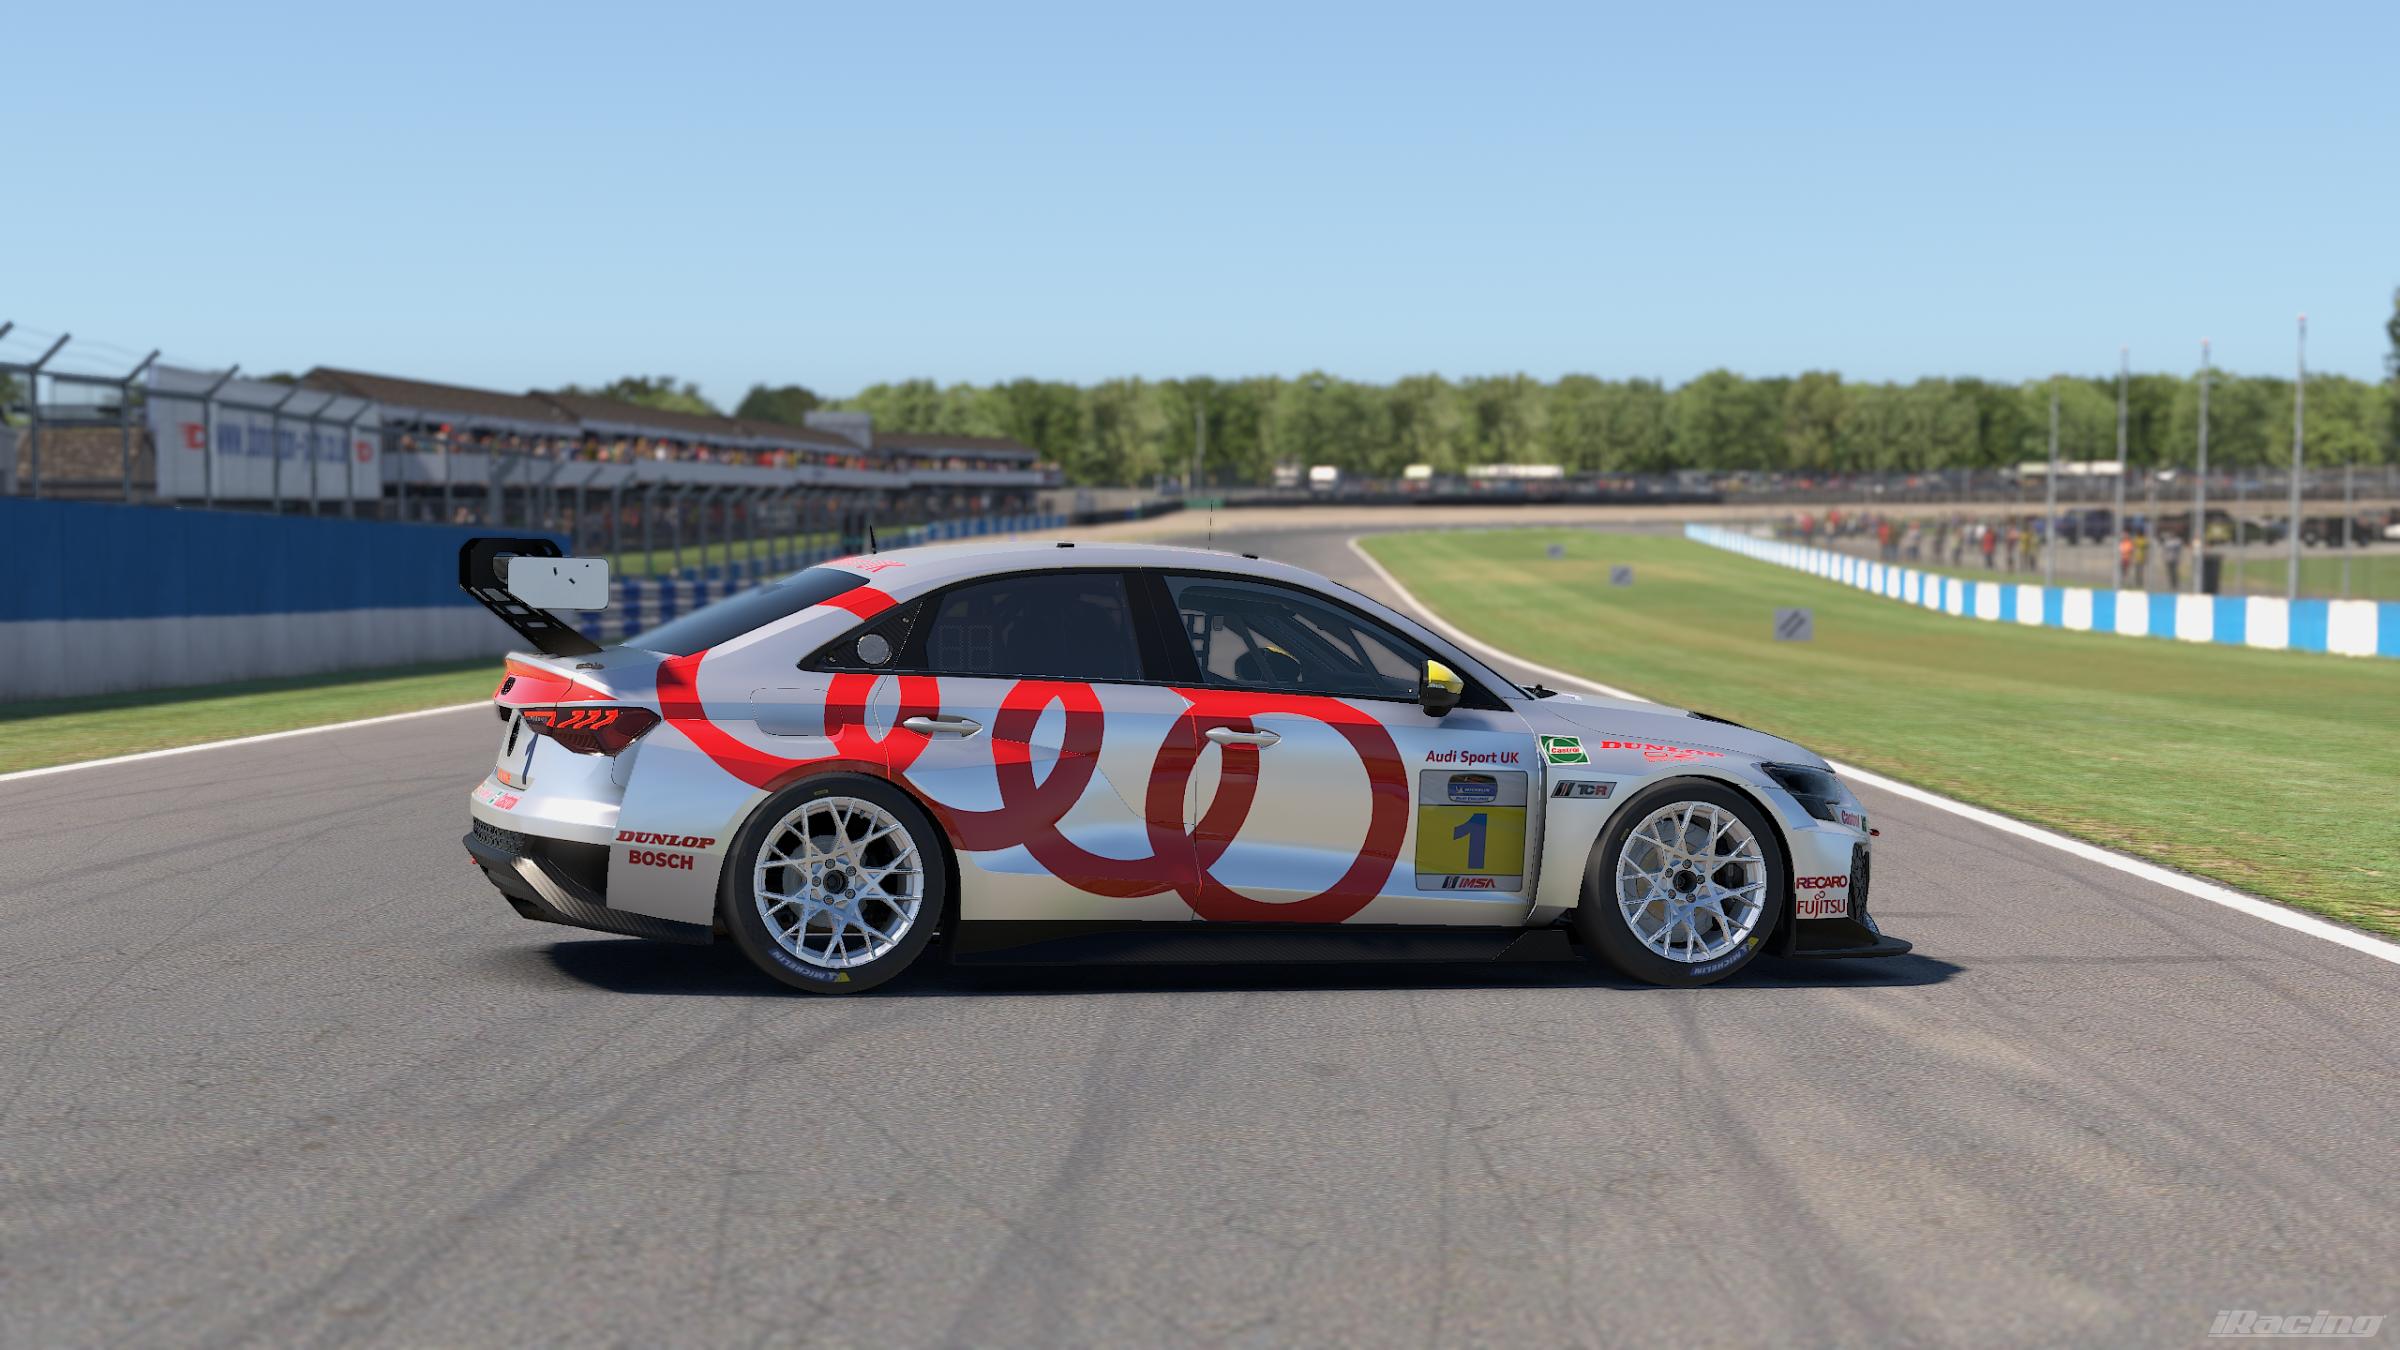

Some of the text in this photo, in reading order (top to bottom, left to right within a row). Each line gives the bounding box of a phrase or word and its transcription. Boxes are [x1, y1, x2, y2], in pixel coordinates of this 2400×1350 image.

[1600, 740, 1727, 757] DUNLOP
[1425, 750, 1519, 766] Audi Sport UK
[1578, 784, 1607, 796] TCR
[616, 830, 716, 849] DUNLOP
[1453, 813, 1488, 869] 1
[629, 850, 694, 870] BOSCH
[1459, 878, 1496, 889] IMSA
[1796, 875, 1848, 889] RECARO
[1797, 899, 1846, 918] FUJITSU
[1694, 950, 1741, 974] MICHELIN
